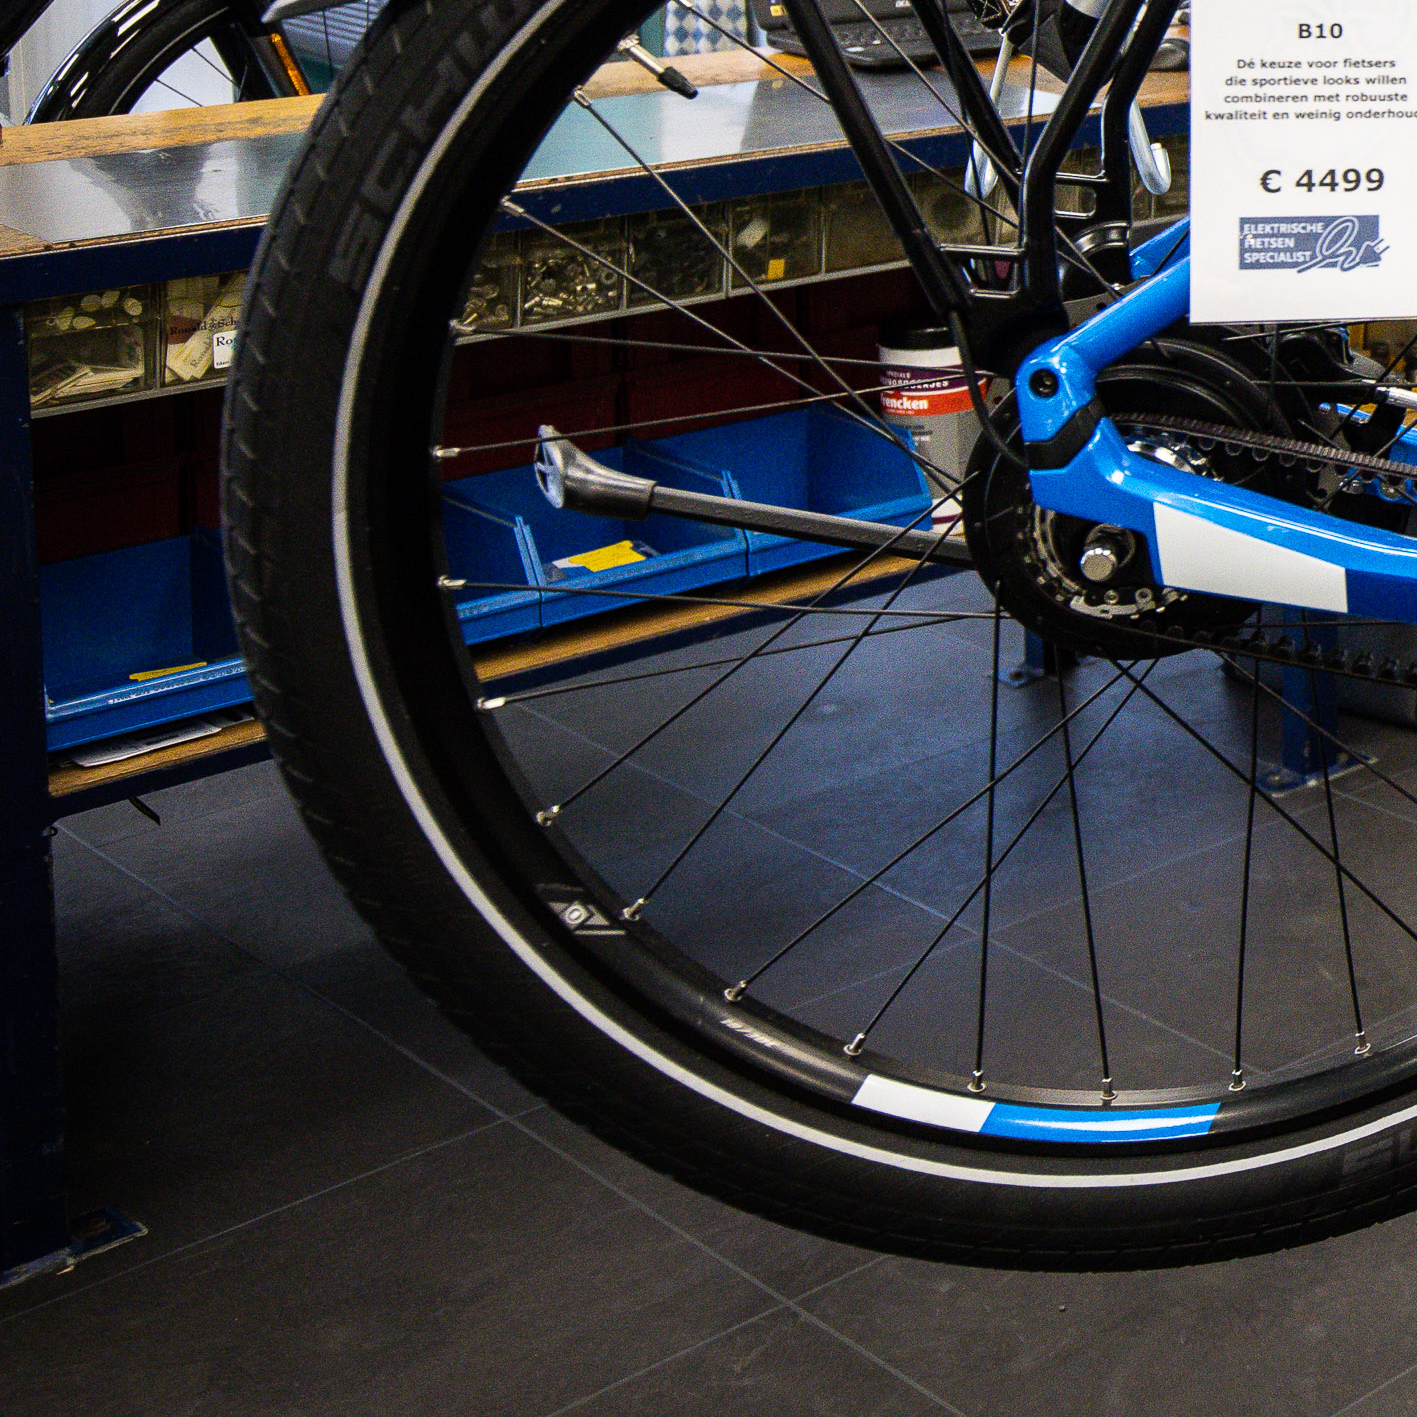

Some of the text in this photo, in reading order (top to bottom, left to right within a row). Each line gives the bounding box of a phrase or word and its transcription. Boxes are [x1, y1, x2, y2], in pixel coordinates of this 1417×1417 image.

[1298, 23, 1344, 40] B10
[1236, 57, 1397, 69] Dé keuze voor fietsers
[1225, 75, 1407, 88] die sportieve looks willen
[1223, 92, 1409, 104] combineren met robuuste
[1204, 110, 1268, 121] kwaliteit
[1271, 111, 1290, 120] en
[1294, 109, 1342, 121] weinig
[1259, 167, 1385, 193] € 4499
[1243, 222, 1326, 235] ELEKTRISCHE
[1244, 237, 1296, 249] FIETSEN
[1243, 250, 1313, 264] SPECIALIST
